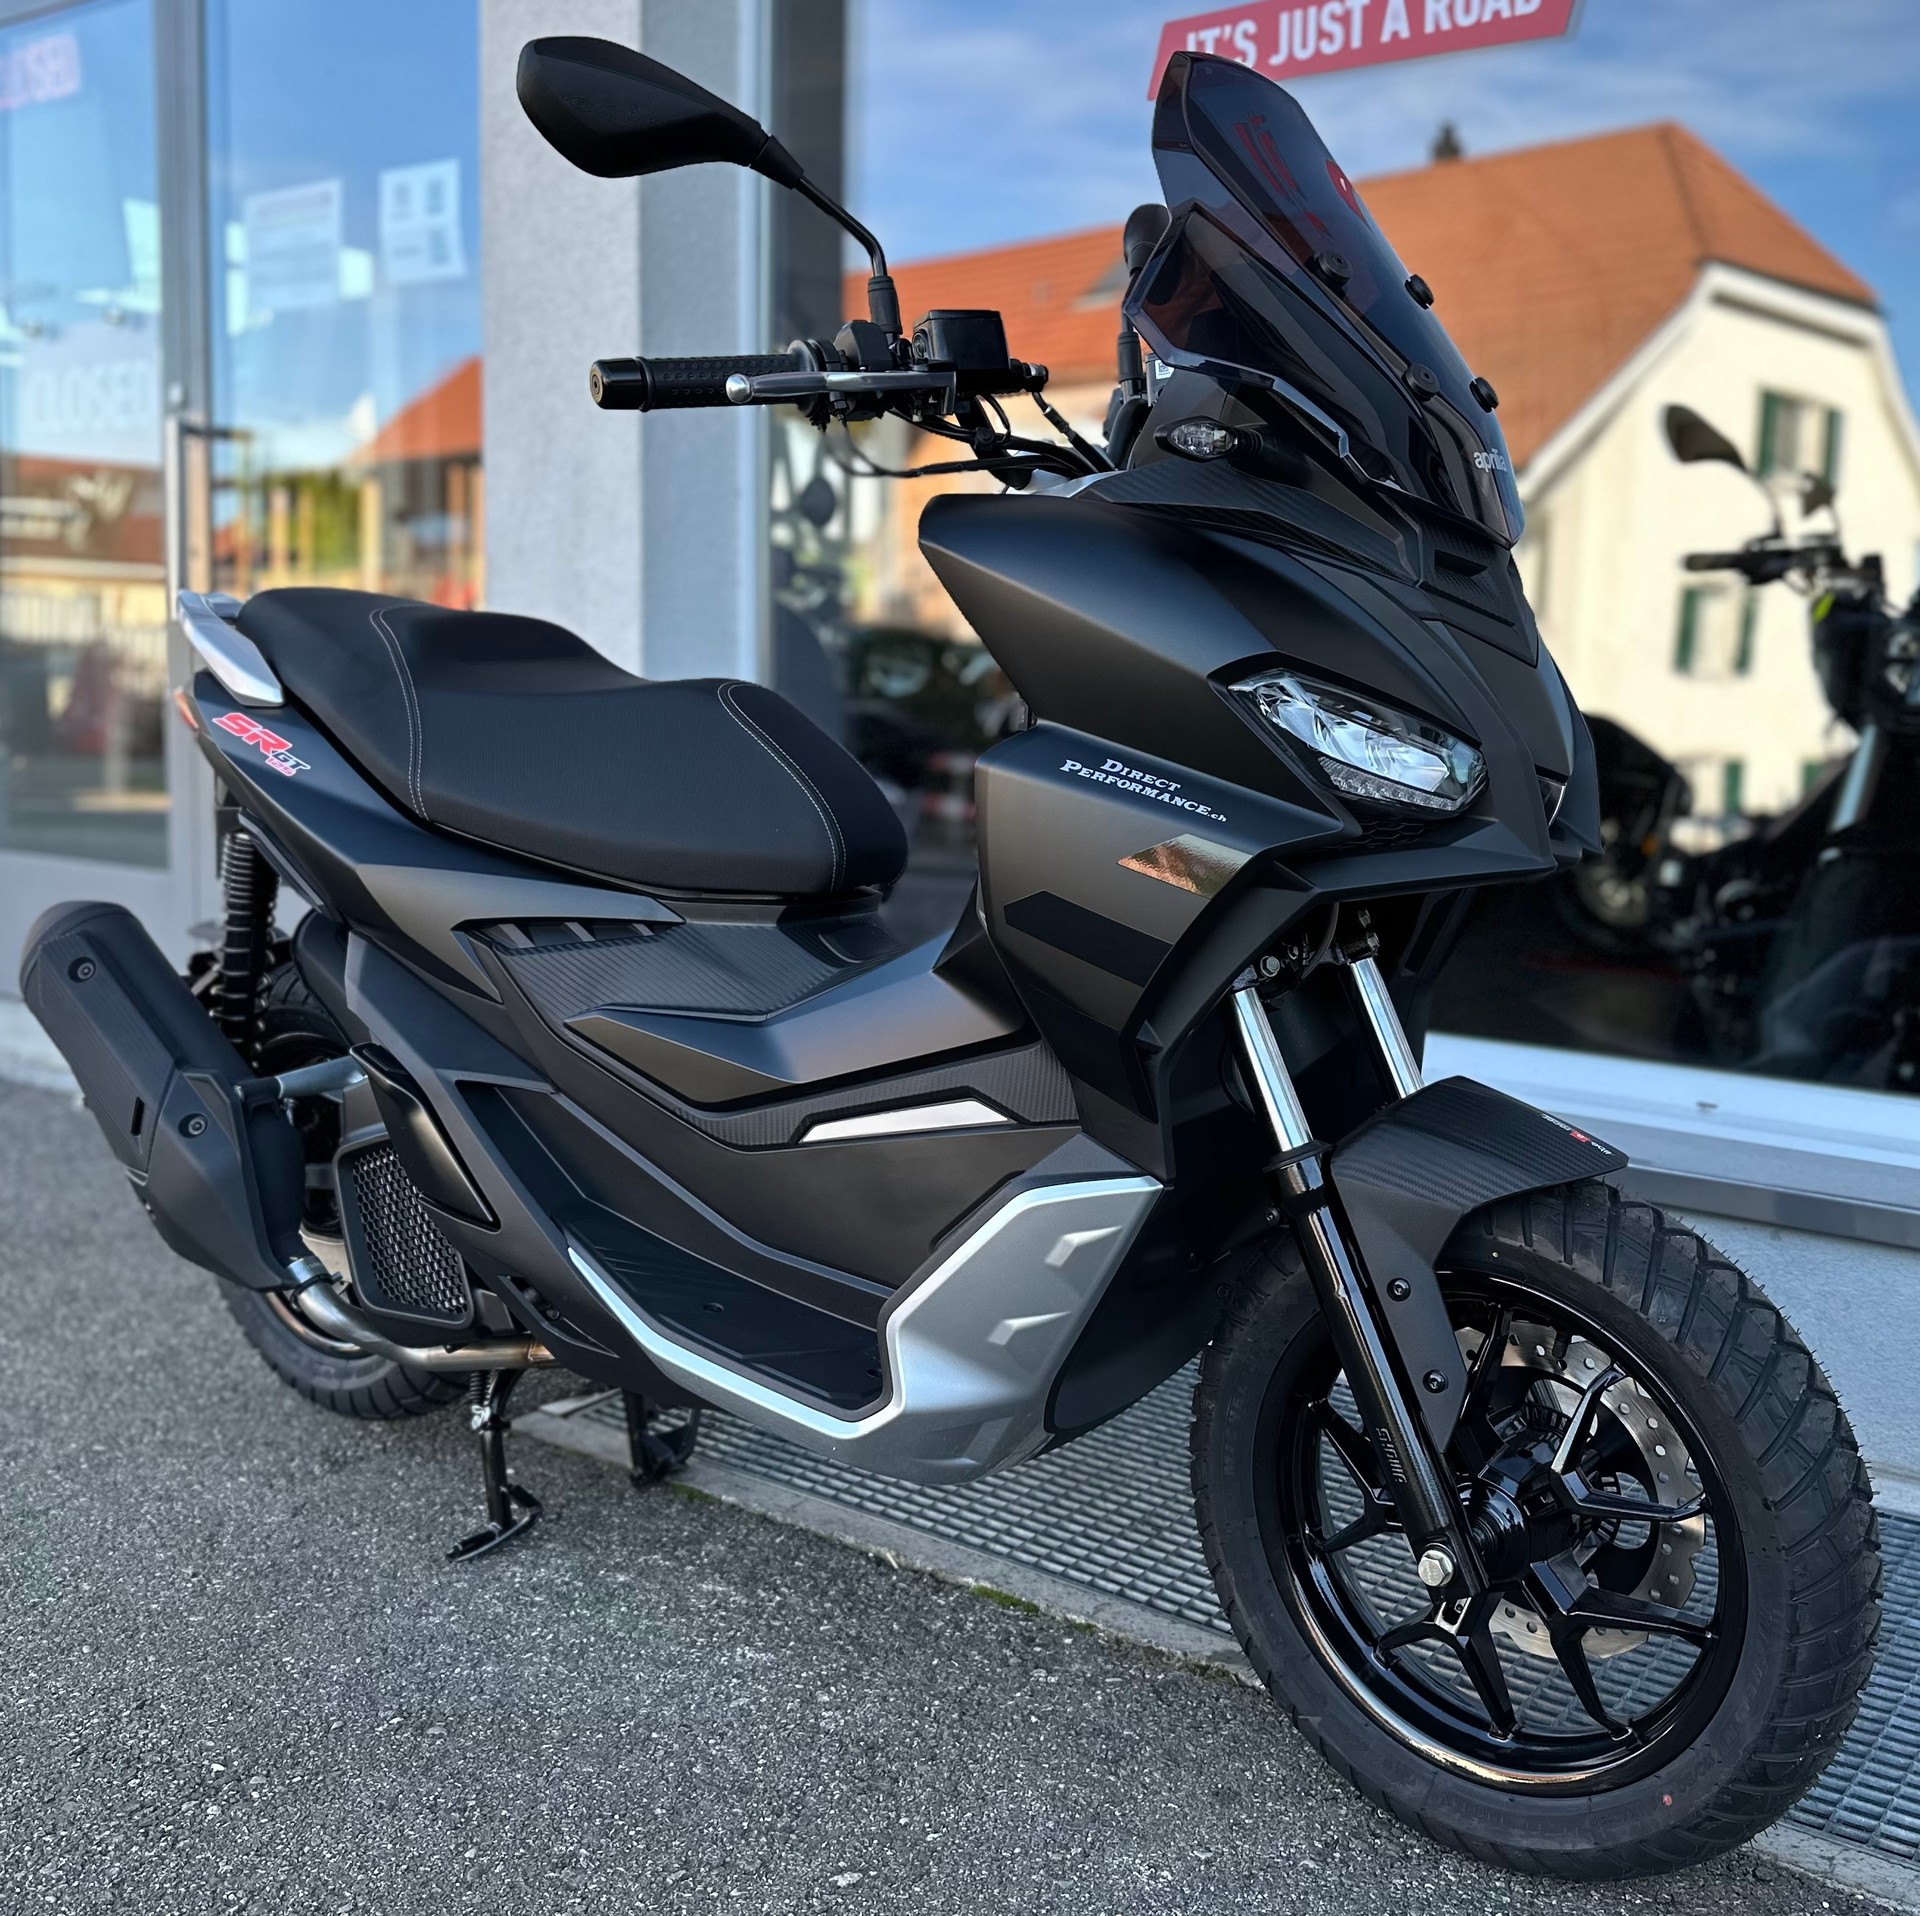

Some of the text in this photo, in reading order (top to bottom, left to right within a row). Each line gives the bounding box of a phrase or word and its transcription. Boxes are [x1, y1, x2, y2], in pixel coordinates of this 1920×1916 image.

[1268, 0, 1371, 66] JUST
[1380, 0, 1411, 43] A
[1424, 0, 1543, 34] RO
[212, 712, 312, 770] SR GT
[1059, 759, 1228, 823] PERFORMANCE.ch
[1099, 758, 1181, 792] DIRECT
